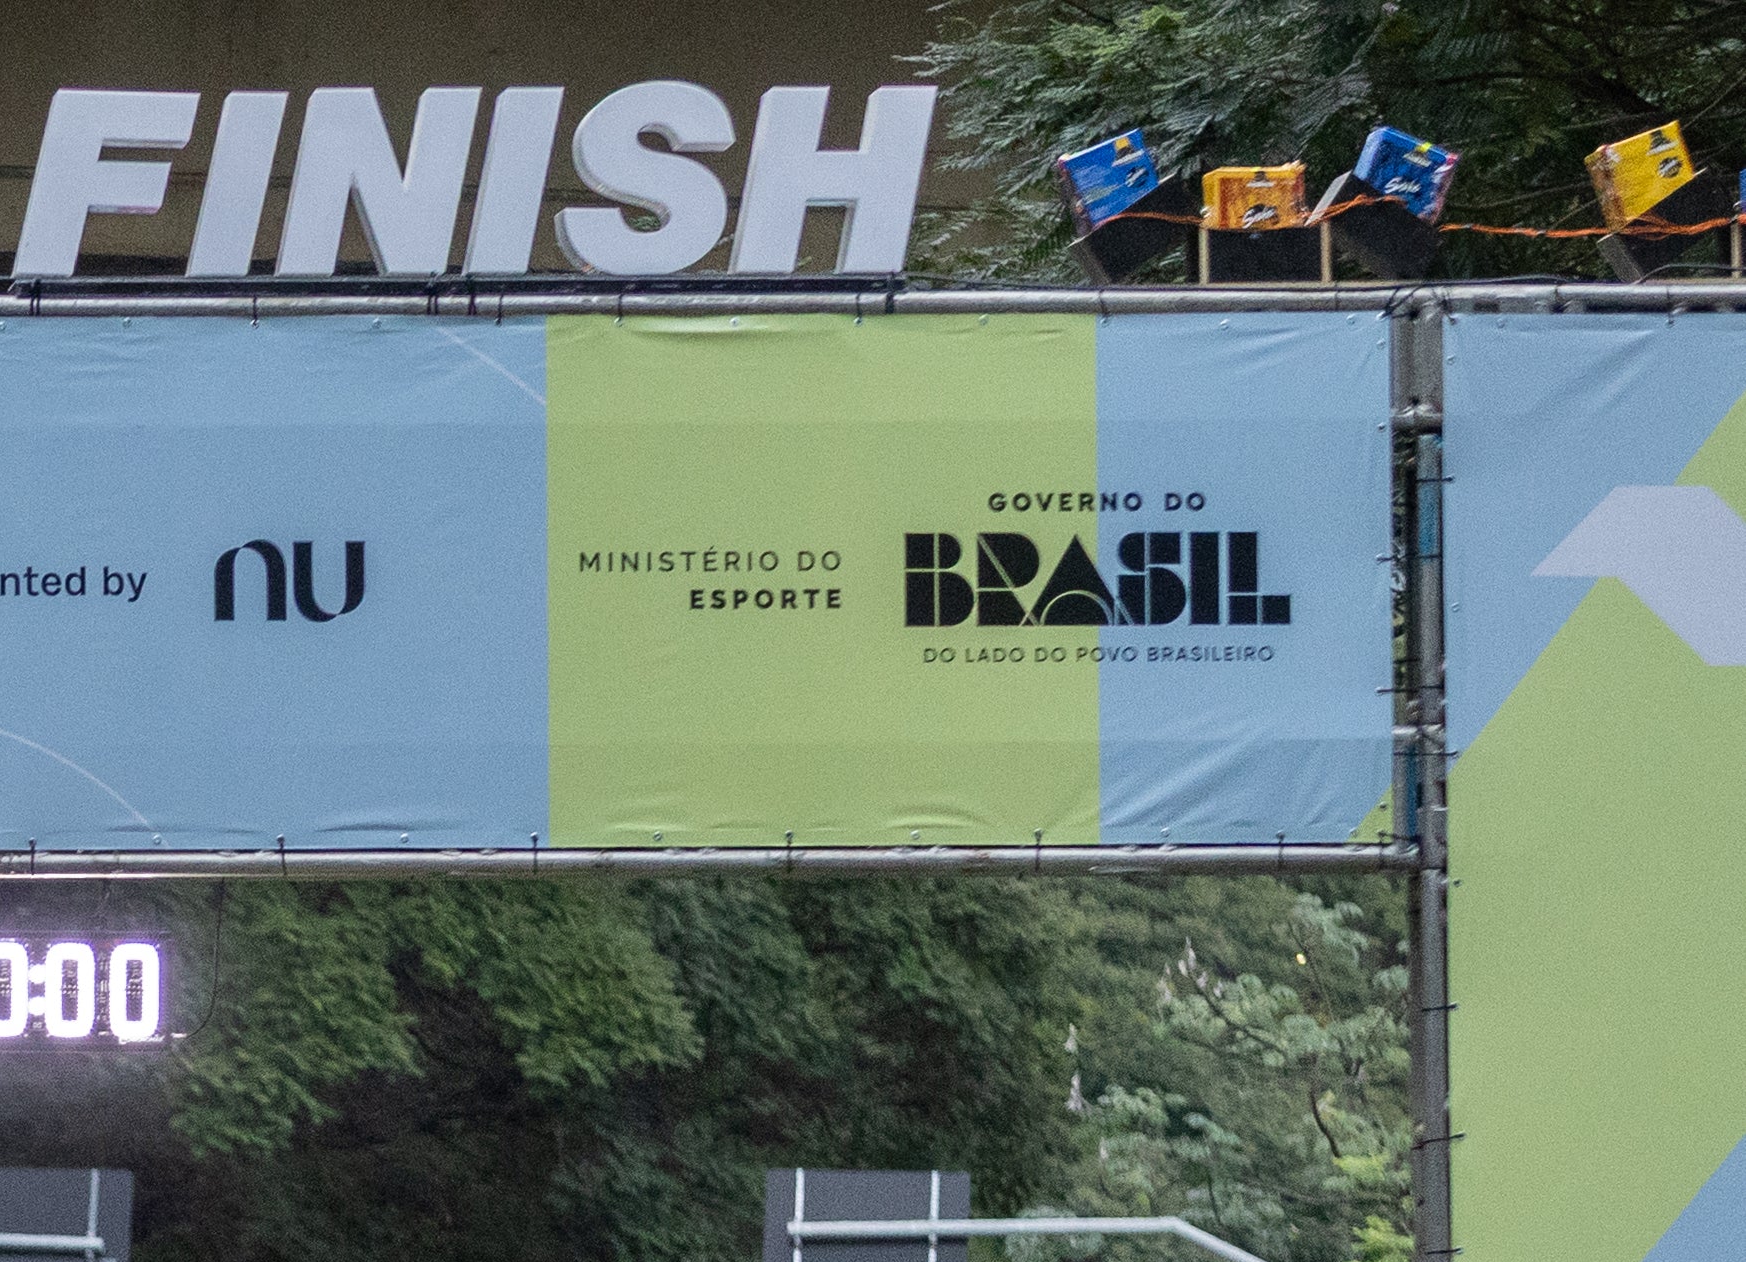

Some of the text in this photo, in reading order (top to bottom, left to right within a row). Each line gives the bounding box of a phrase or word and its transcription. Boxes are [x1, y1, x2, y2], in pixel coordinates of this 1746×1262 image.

[14, 80, 938, 276] FINISH
[988, 493, 1206, 513] GOVERNO DO
[580, 546, 842, 572] MINISTÉRIO DO
[103, 566, 147, 603] by
[904, 531, 1291, 627] BRASIL
[690, 588, 843, 611] ESPORTE
[923, 645, 1276, 664] DO LADO DO POVO BRASILEIRO
